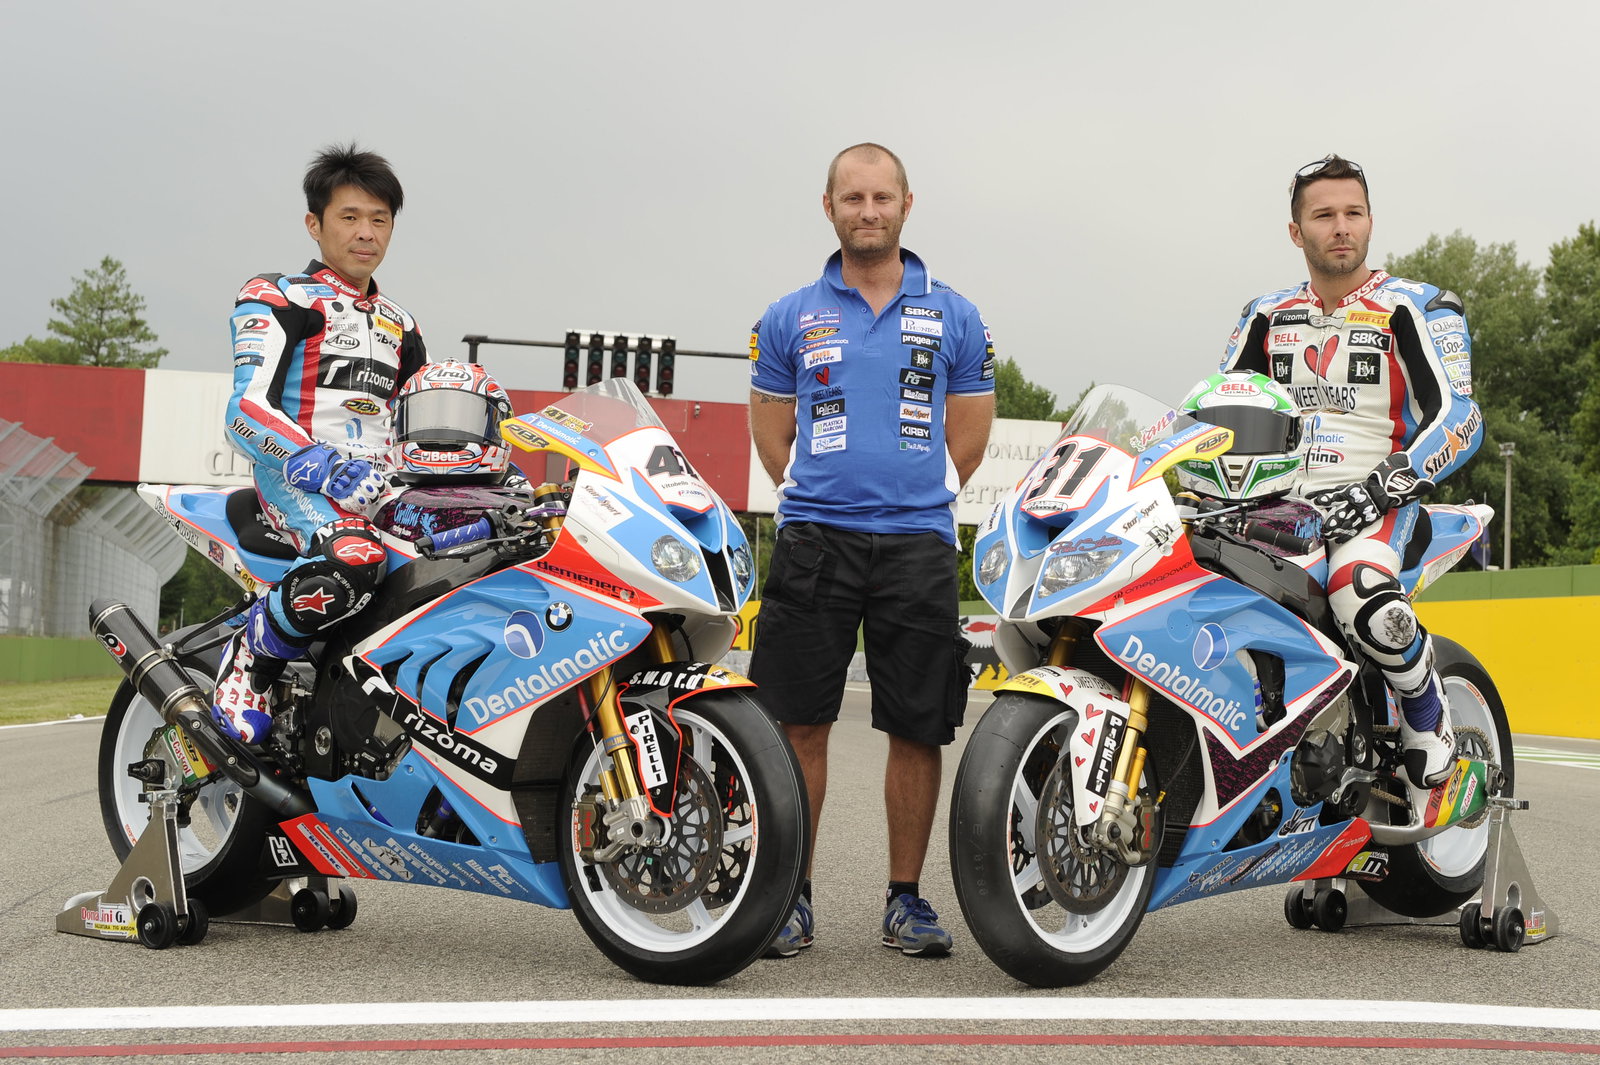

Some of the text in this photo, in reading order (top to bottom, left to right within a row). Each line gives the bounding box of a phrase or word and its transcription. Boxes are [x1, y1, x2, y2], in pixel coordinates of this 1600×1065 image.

[1282, 313, 1307, 321] rizoma
[1349, 312, 1387, 325] PIRELLI
[332, 335, 356, 346] Arai
[902, 334, 931, 345] progea
[1274, 333, 1300, 343] BELL
[1351, 333, 1382, 347] SBK
[356, 367, 395, 391] rizoma
[434, 368, 466, 379] Arai
[1220, 383, 1256, 393] BELL
[1323, 385, 1356, 411] YEARS
[901, 408, 930, 420] Star Sport
[229, 417, 257, 438] Star
[537, 420, 581, 445] Dentalmatic
[901, 425, 929, 438] KIRBY
[259, 436, 290, 460] Spor
[1426, 445, 1451, 480] Star
[1455, 407, 1481, 447] Sport
[432, 452, 460, 461] Beta
[1026, 443, 1109, 501] 31
[582, 485, 622, 516] Star Sport
[1122, 500, 1159, 533] Star Sport
[464, 629, 630, 725] Dentalmatic
[1014, 674, 1040, 686] eni
[1118, 635, 1247, 731] Dentalmatic
[403, 711, 498, 774] rizoma
[638, 714, 662, 783] PIRELLI
[1095, 715, 1123, 793] PIRELLI
[173, 741, 191, 776] Castrol
[1463, 777, 1477, 809] Castrol
[308, 835, 342, 871] REVARC
[349, 840, 391, 880] Beta
[408, 842, 450, 876] progea
[488, 864, 515, 885] FG
[115, 911, 126, 923] G.
